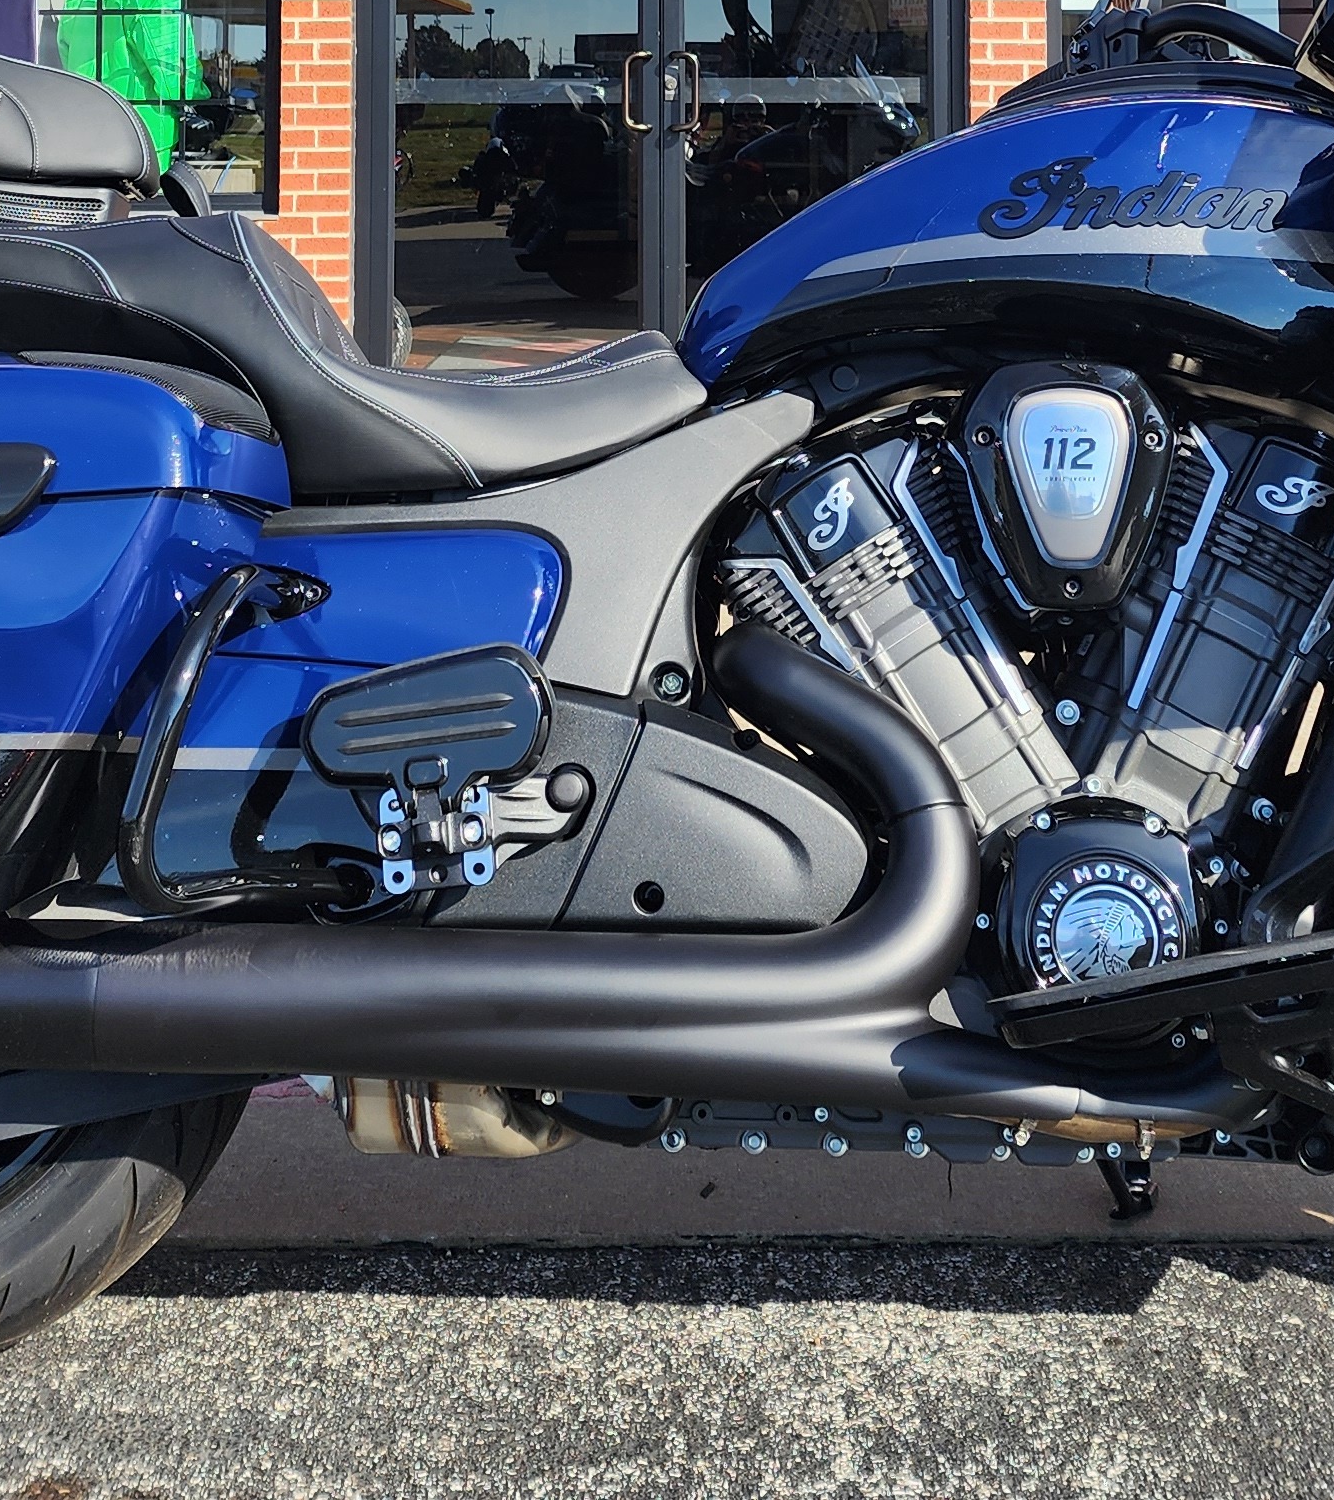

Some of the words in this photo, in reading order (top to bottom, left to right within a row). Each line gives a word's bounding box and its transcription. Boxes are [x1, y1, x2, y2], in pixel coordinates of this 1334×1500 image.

[977, 156, 1289, 240] Indian
[1042, 437, 1097, 470] 112
[1072, 863, 1179, 964] MOTORCYC
